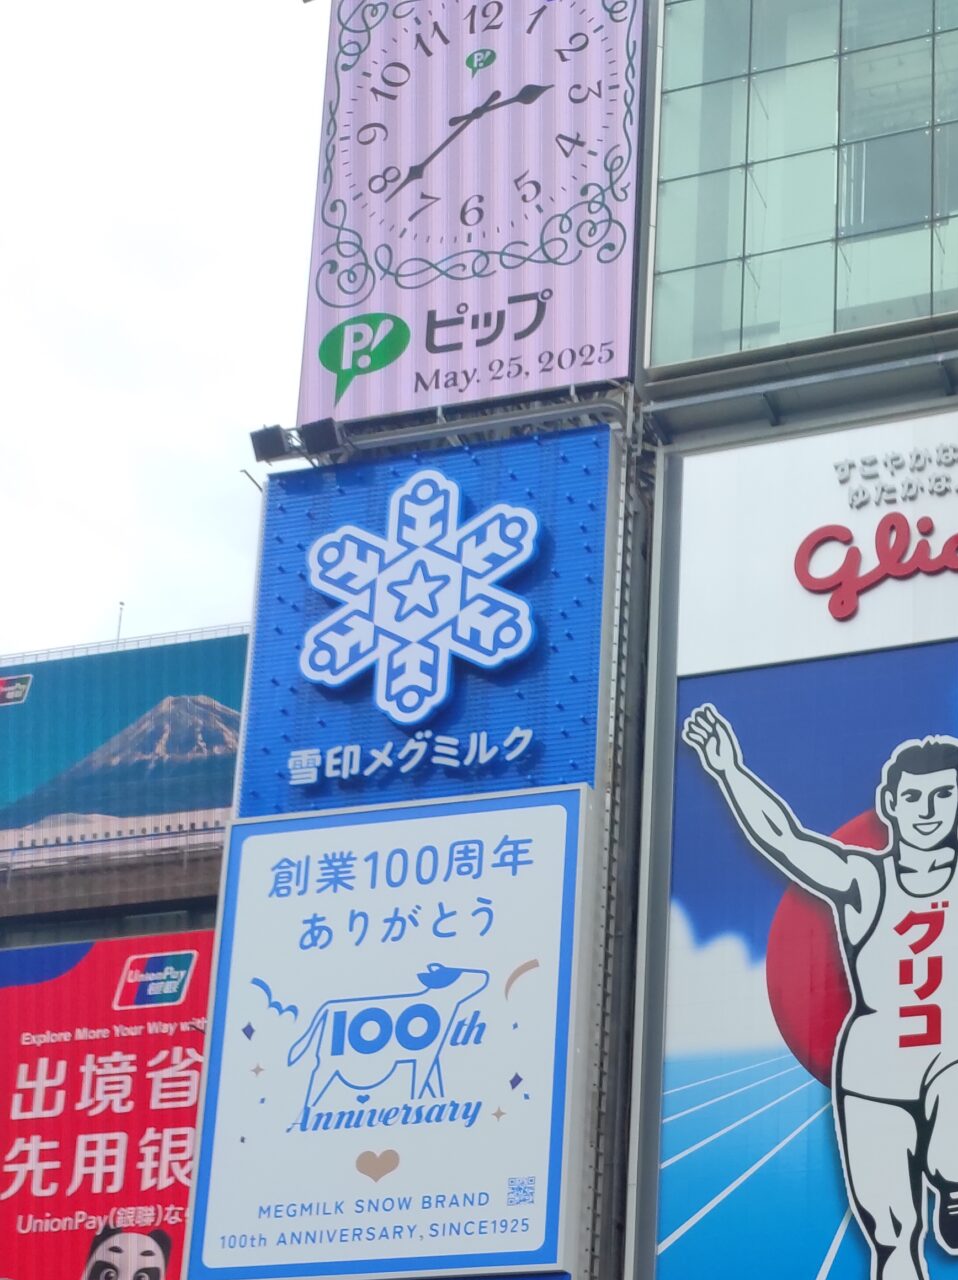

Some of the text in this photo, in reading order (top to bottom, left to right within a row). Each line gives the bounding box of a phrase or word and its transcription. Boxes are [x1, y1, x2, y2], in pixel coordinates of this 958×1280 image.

[463, 1, 504, 34] 12
[526, 5, 548, 34] 1
[414, 21, 451, 57] 11
[554, 32, 590, 62] 2
[370, 62, 411, 102] 10
[568, 80, 602, 104] 3
[356, 122, 388, 145] 9
[555, 132, 586, 158] 4
[368, 166, 400, 193] 8
[513, 170, 541, 203] 5
[408, 193, 441, 221] 7
[460, 194, 484, 227] 6
[425, 288, 553, 354] ピップ
[413, 340, 615, 393] May. 25, 2025
[287, 726, 533, 786] 雪印メグミルク
[268, 834, 534, 898] 創業100周年
[298, 896, 495, 951] ありがとう
[127, 966, 186, 984] UnionPay
[893, 900, 949, 1048] グリコ
[21, 1030, 72, 1047] Explore
[75, 1026, 110, 1042] More
[114, 1024, 144, 1038] Your
[147, 1021, 177, 1037] Way
[330, 1002, 487, 1057] 100th
[10, 1046, 205, 1121] 出境省
[286, 1099, 483, 1134] Anniversary
[0, 1126, 196, 1201] 先用银
[16, 1203, 189, 1235] UnionPay(銀聯)な
[258, 1192, 490, 1219] MEGMILK SNOW BRAND
[219, 1232, 267, 1250] 100th
